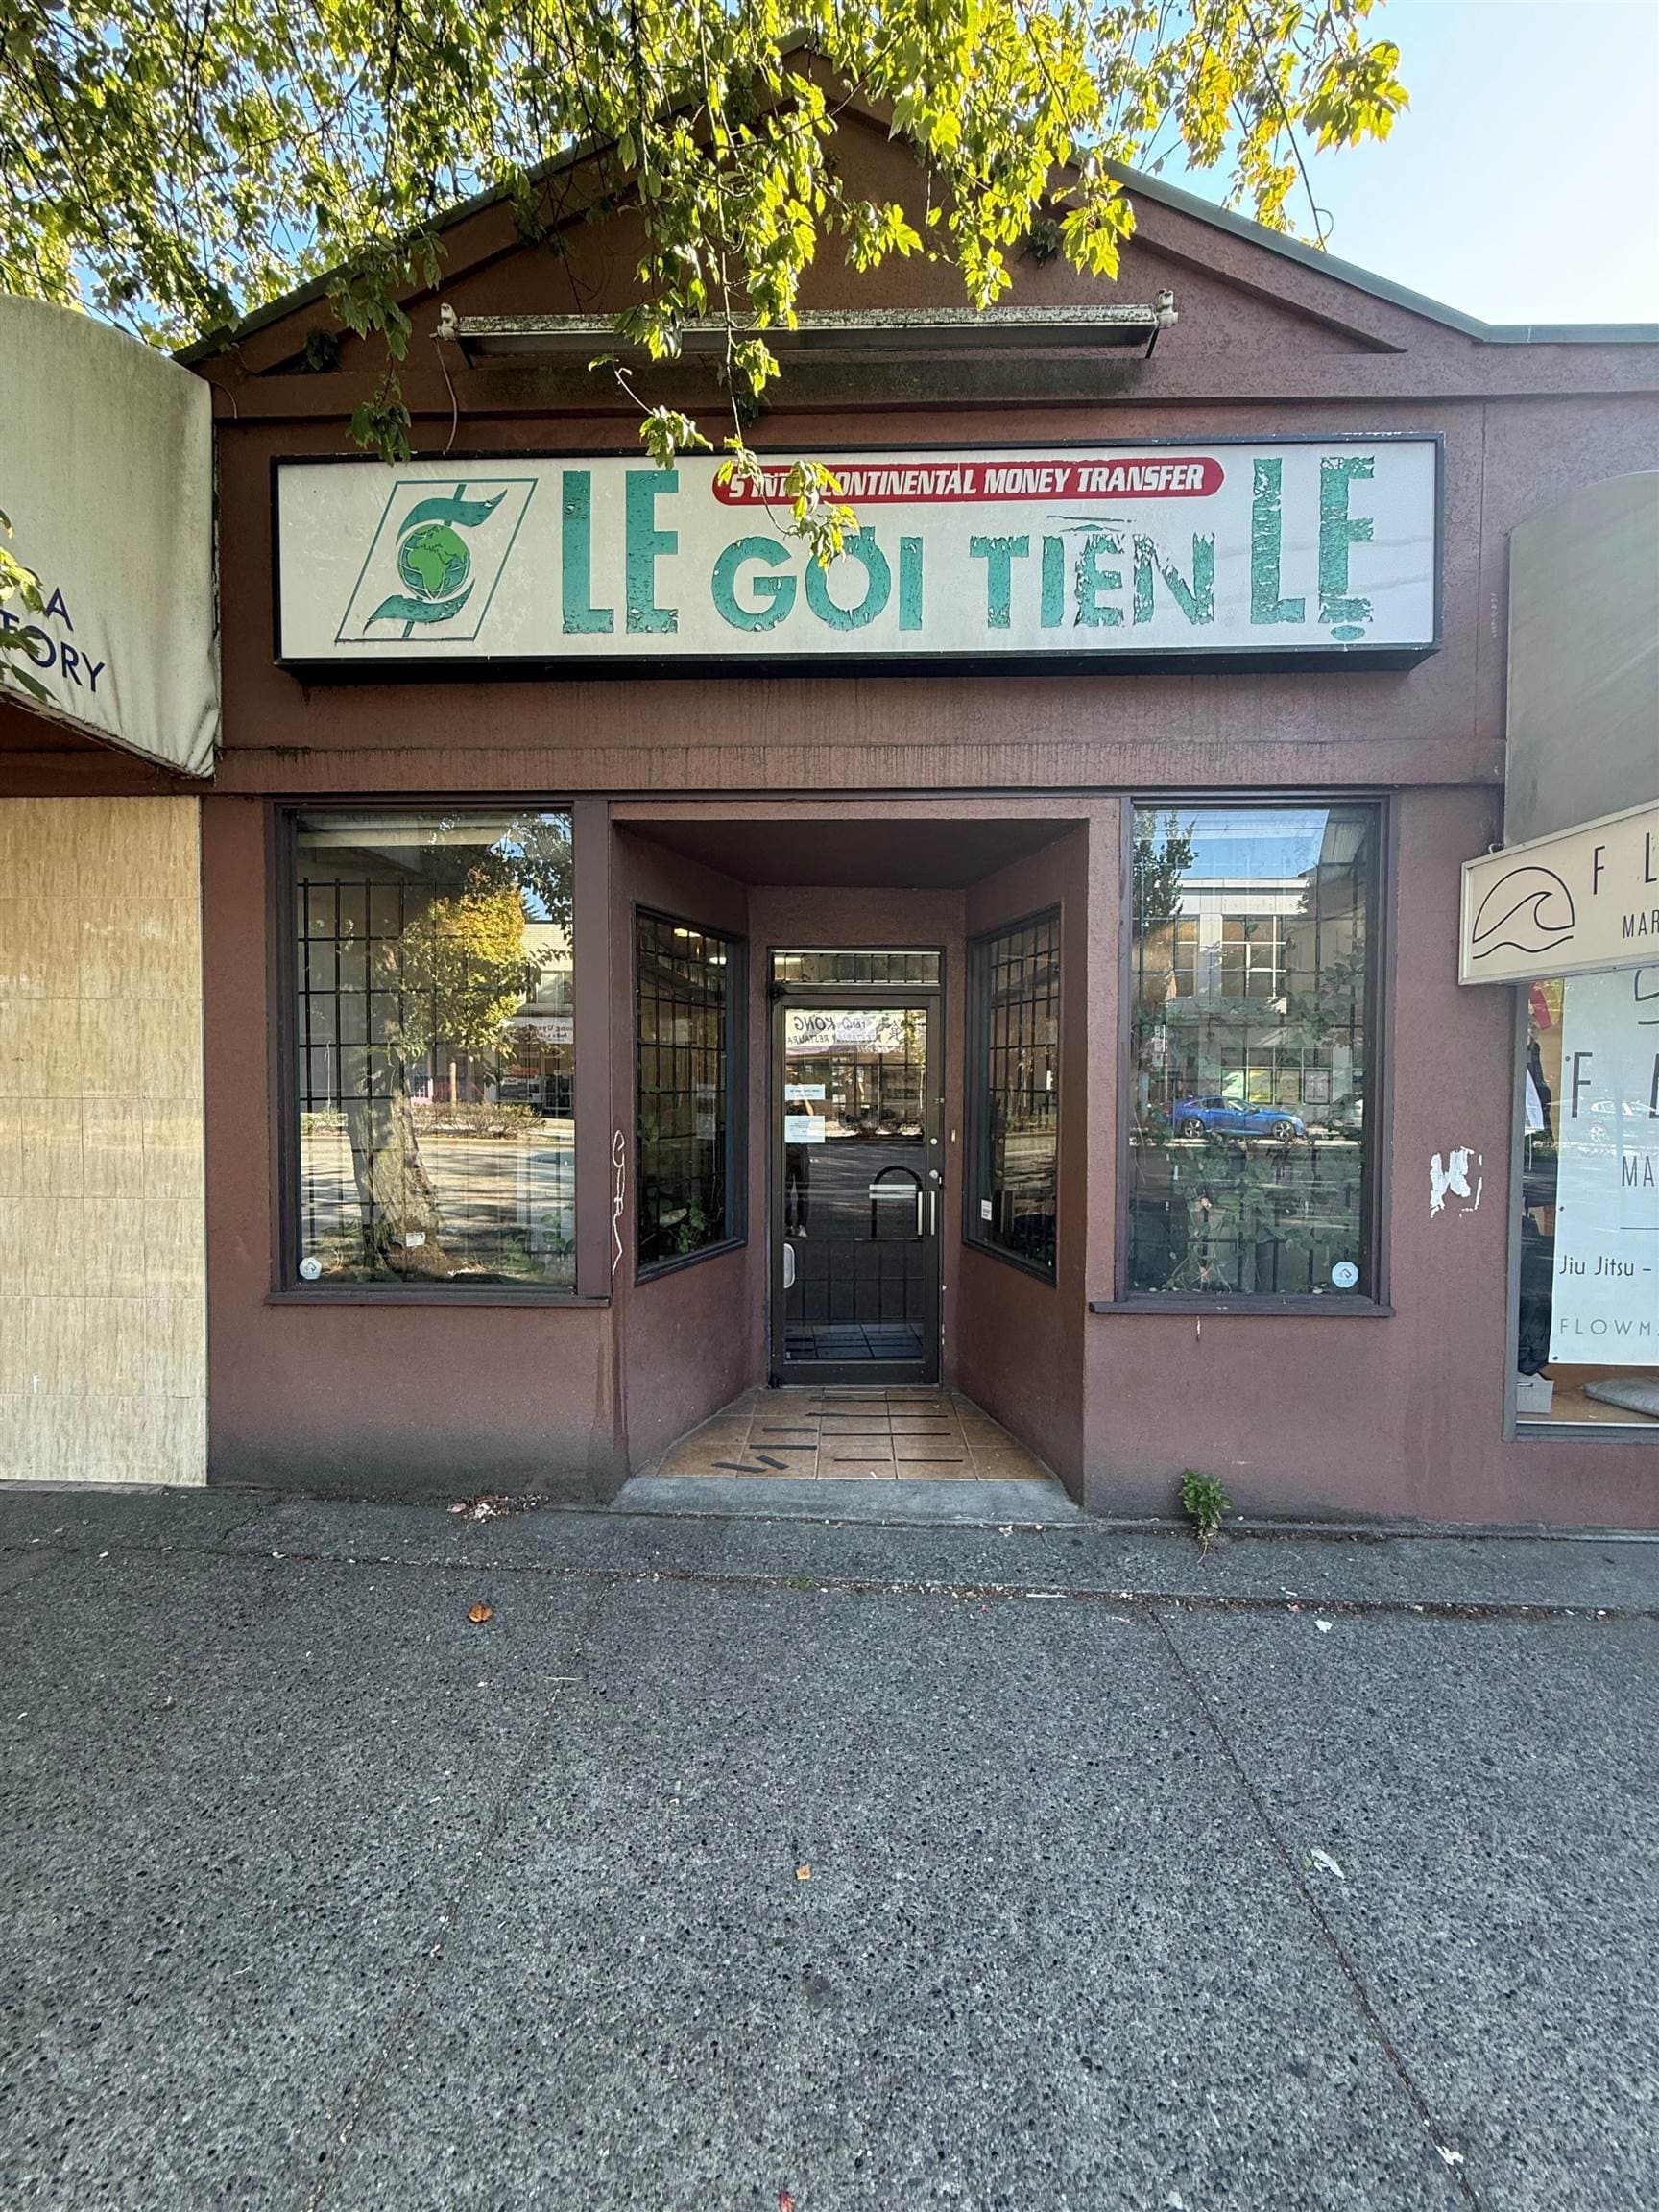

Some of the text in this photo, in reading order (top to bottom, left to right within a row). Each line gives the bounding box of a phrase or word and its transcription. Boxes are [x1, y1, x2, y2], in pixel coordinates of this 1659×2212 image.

[984, 467, 1072, 495] MONEY
[1076, 463, 1205, 493] TRANSFER
[1559, 1255, 1586, 1275] Jiu
[1594, 1256, 1634, 1277] Jitsu
[1560, 1318, 1659, 1336] FLOWM
